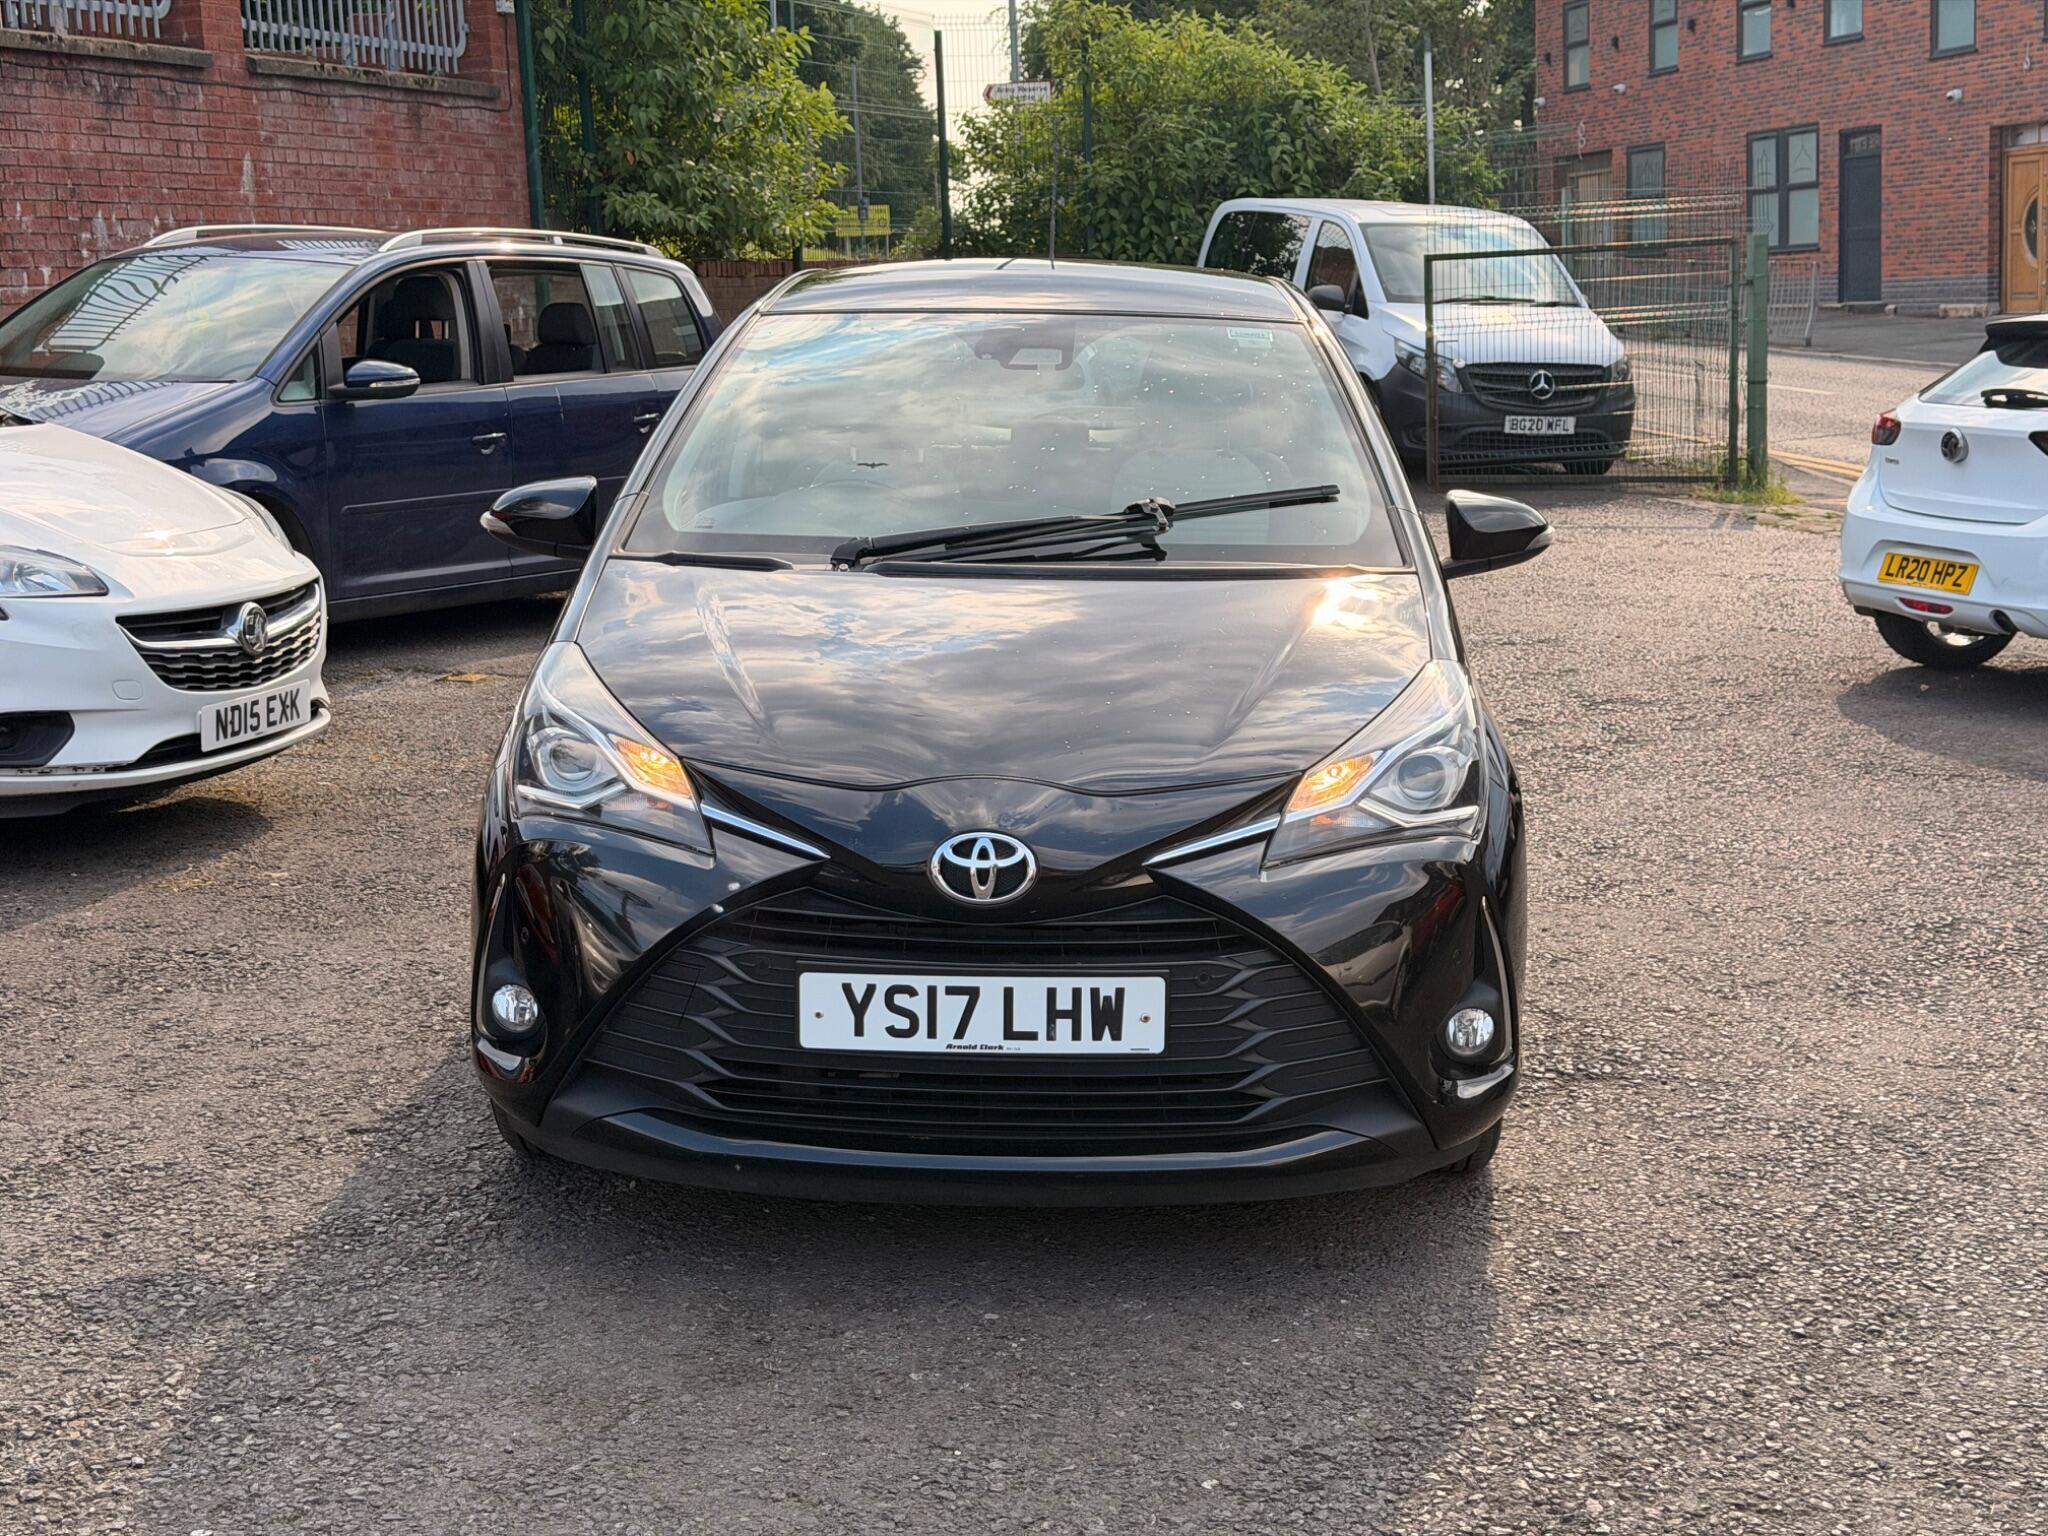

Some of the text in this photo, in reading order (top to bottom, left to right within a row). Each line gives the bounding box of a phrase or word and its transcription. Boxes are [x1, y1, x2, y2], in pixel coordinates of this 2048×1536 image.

[1511, 418, 1543, 431] BG20
[1885, 555, 1968, 587] LR20 HPZ
[215, 688, 300, 741] ND15 EXK
[841, 982, 1125, 1042] YS17 LHW
